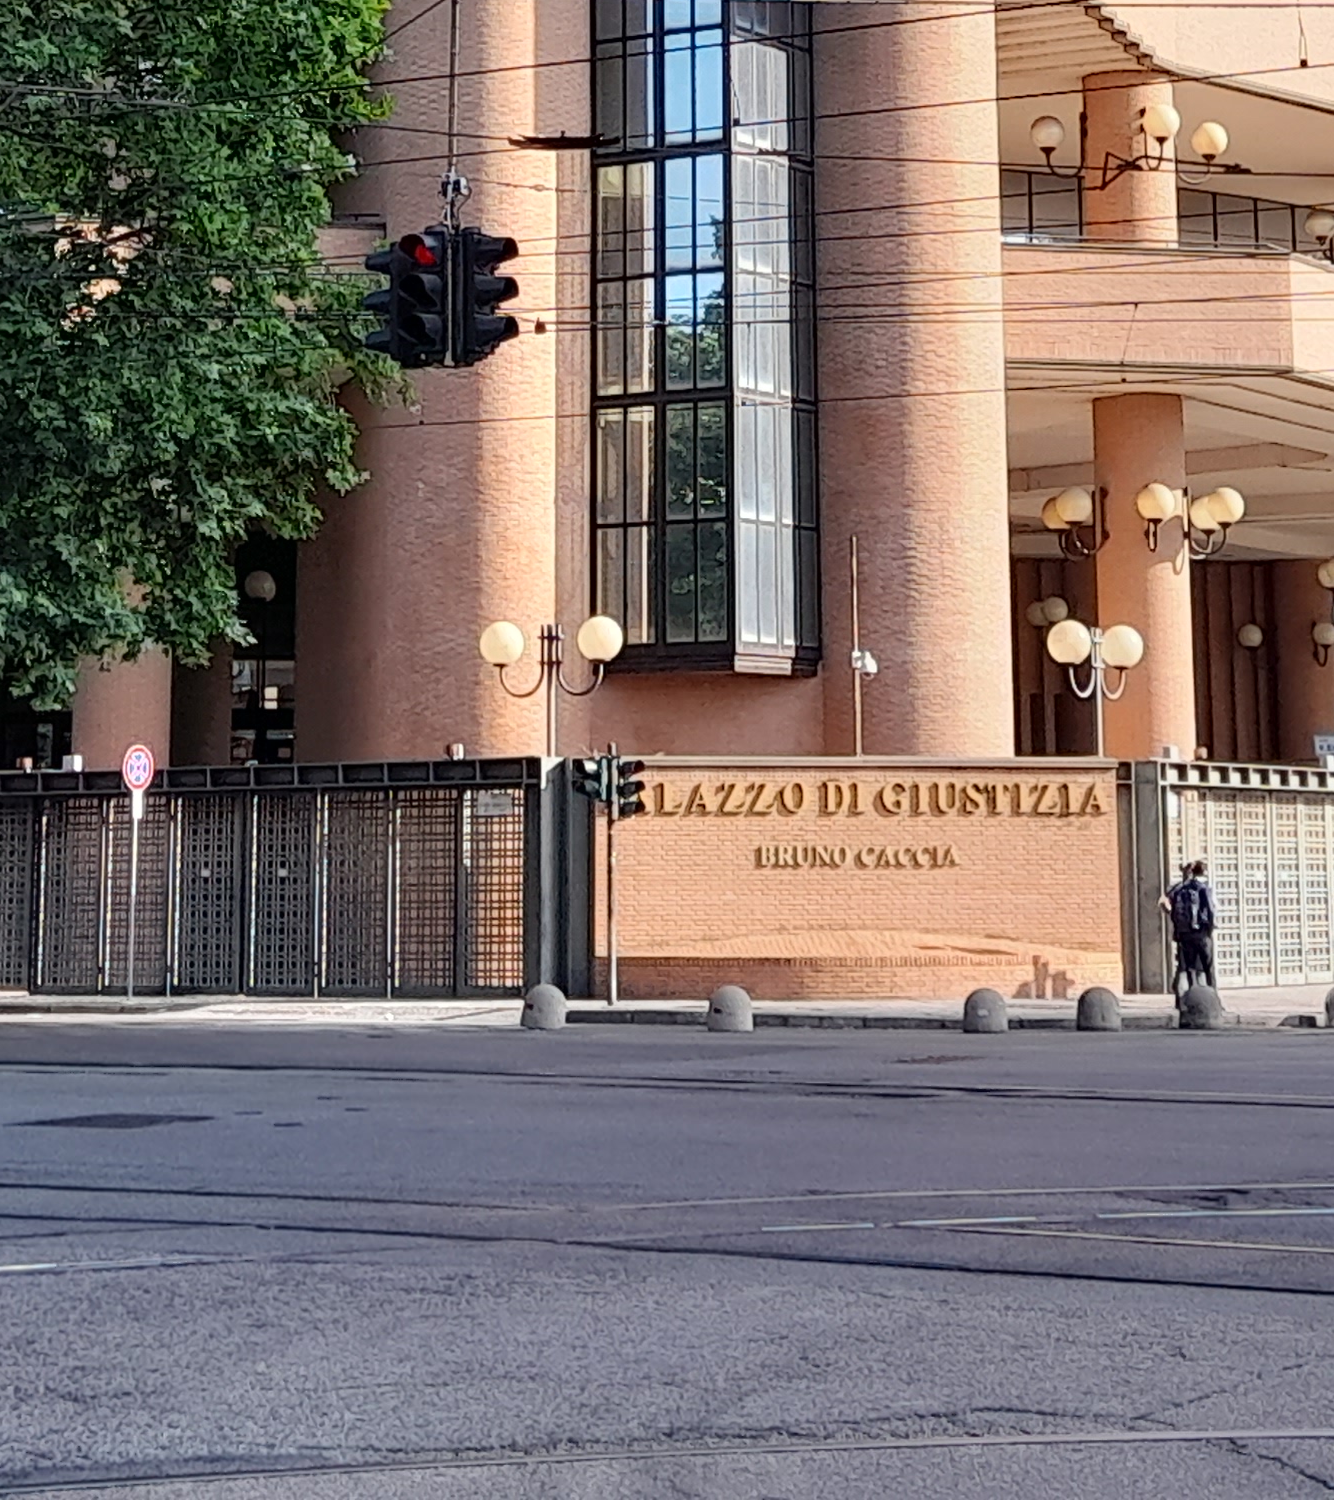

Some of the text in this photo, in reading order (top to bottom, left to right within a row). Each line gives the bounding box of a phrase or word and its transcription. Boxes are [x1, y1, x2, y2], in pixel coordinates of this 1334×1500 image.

[635, 779, 1108, 818] LAZZO DI GIUSTIZIA
[755, 845, 962, 871] BRUNO CACCIA
